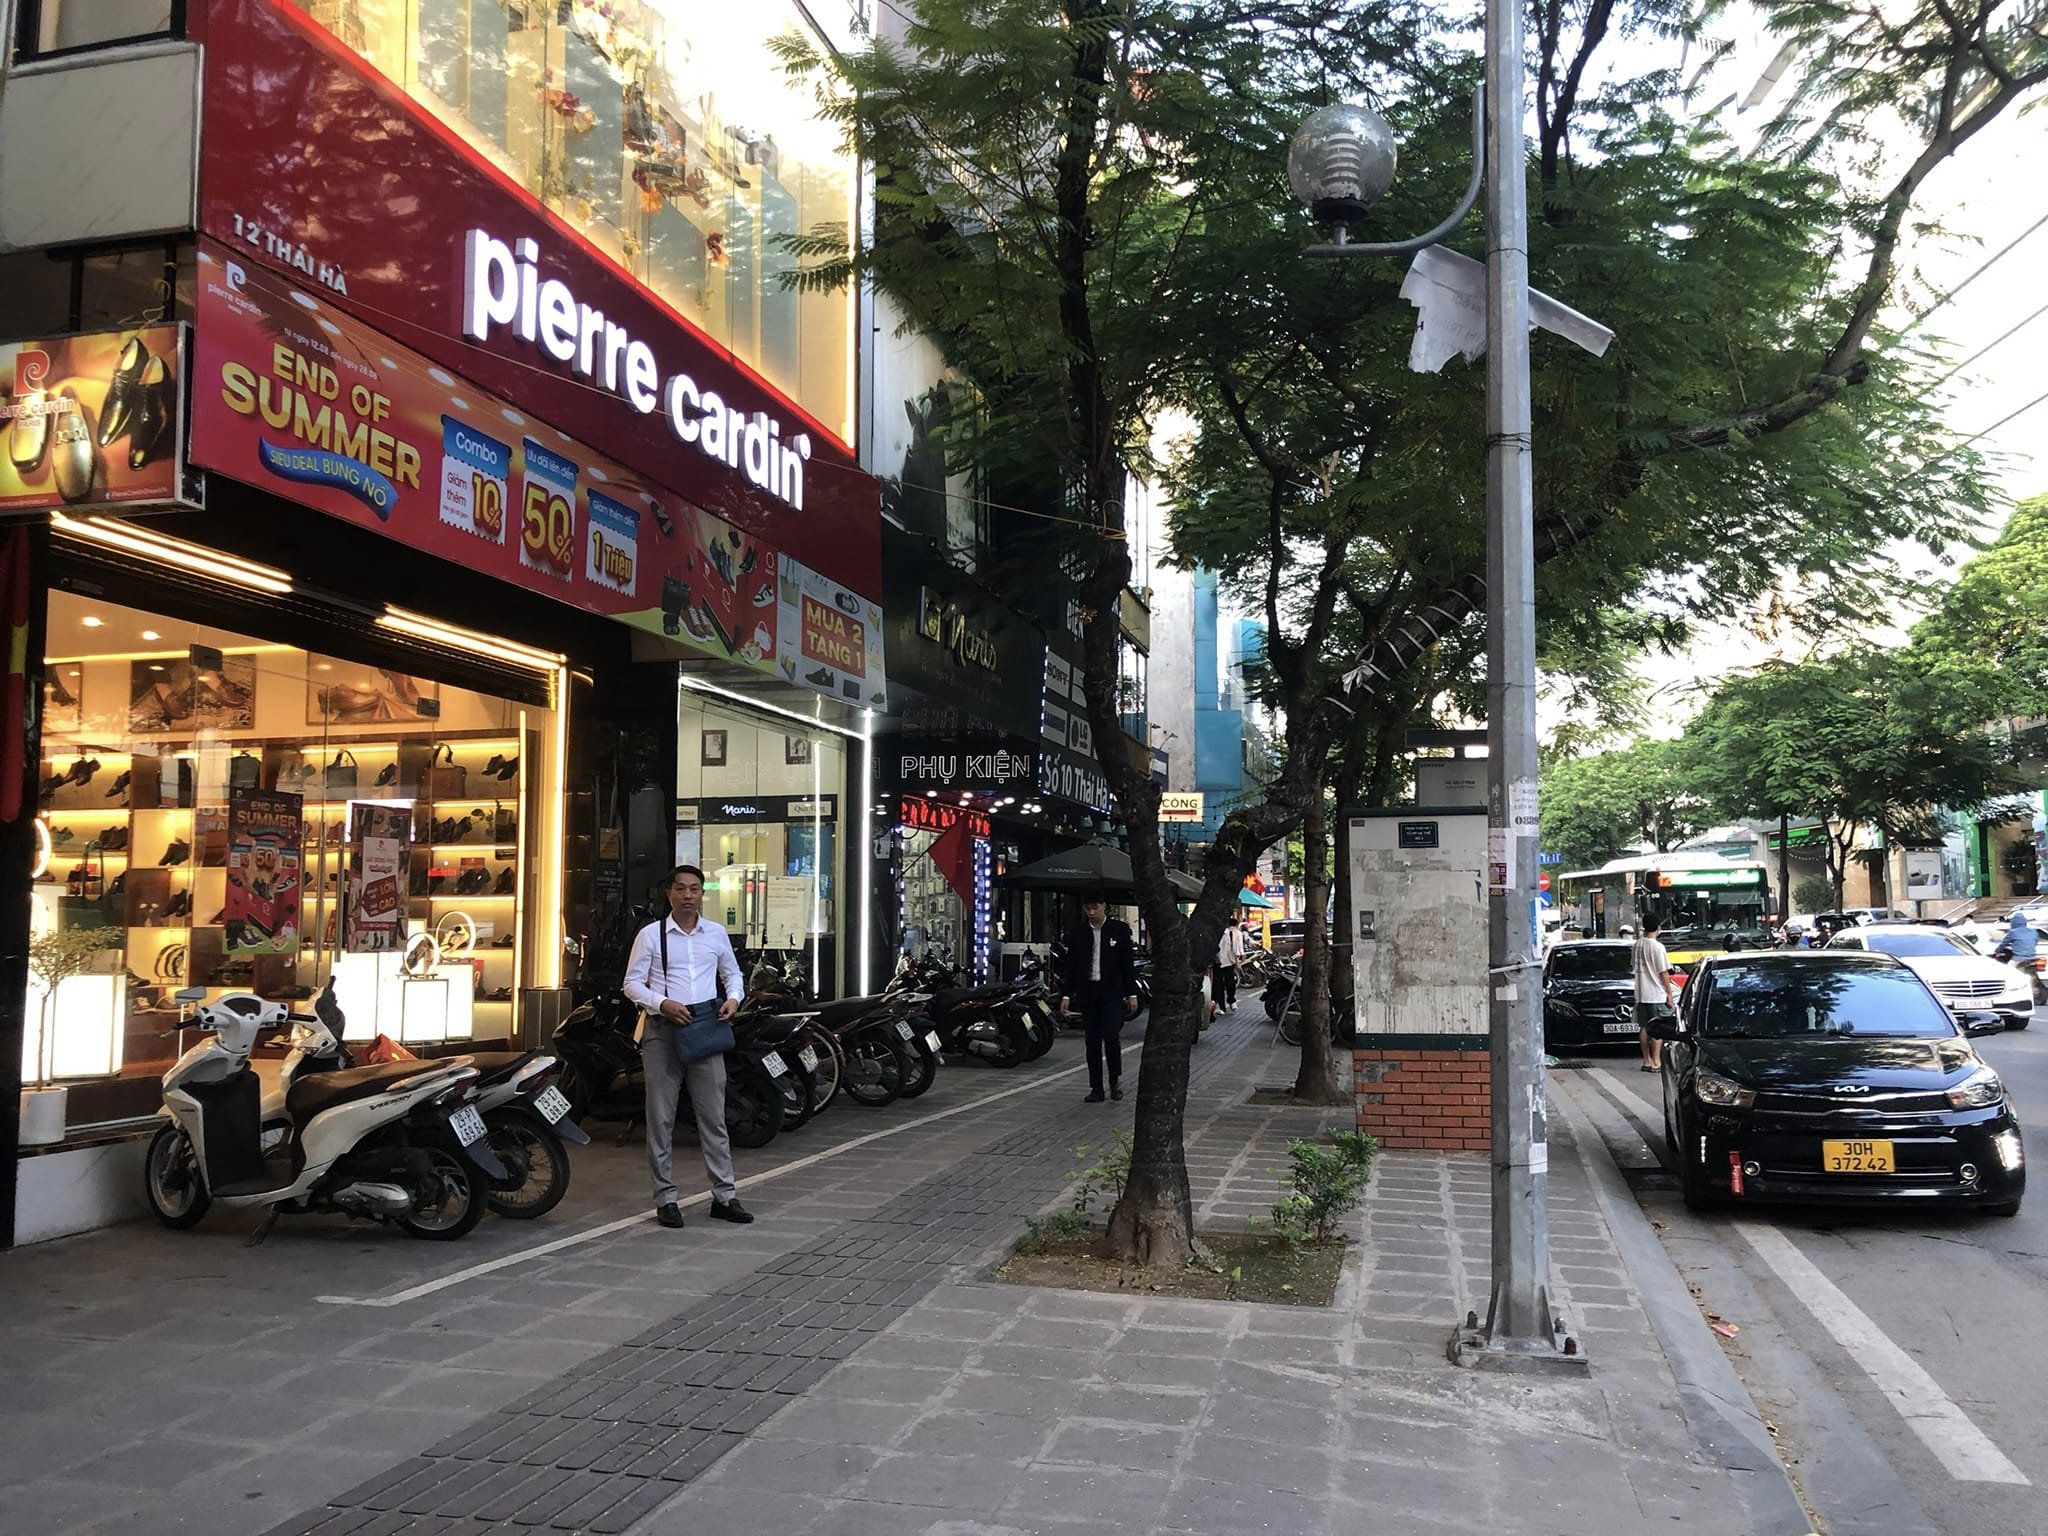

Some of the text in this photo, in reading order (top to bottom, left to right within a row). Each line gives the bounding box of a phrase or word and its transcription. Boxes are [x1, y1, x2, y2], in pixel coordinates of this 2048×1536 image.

[233, 213, 260, 246] 12
[317, 263, 348, 296] HÀ
[273, 342, 391, 422] END OF
[463, 229, 803, 511] pierre cardin
[221, 361, 421, 489] SUMMER
[292, 455, 320, 473] DEAL
[456, 431, 498, 465] Combo
[592, 530, 603, 571] 1
[806, 600, 862, 645] MUA 2
[855, 651, 861, 669] 1
[901, 755, 957, 784] PHỤ
[965, 749, 1030, 784] KIỆN
[1044, 752, 1108, 809] Số 10 Thái Hà
[237, 810, 297, 828] SUMMER
[1832, 1157, 1887, 1171] 372.42
[1843, 1142, 1873, 1155] 30H
